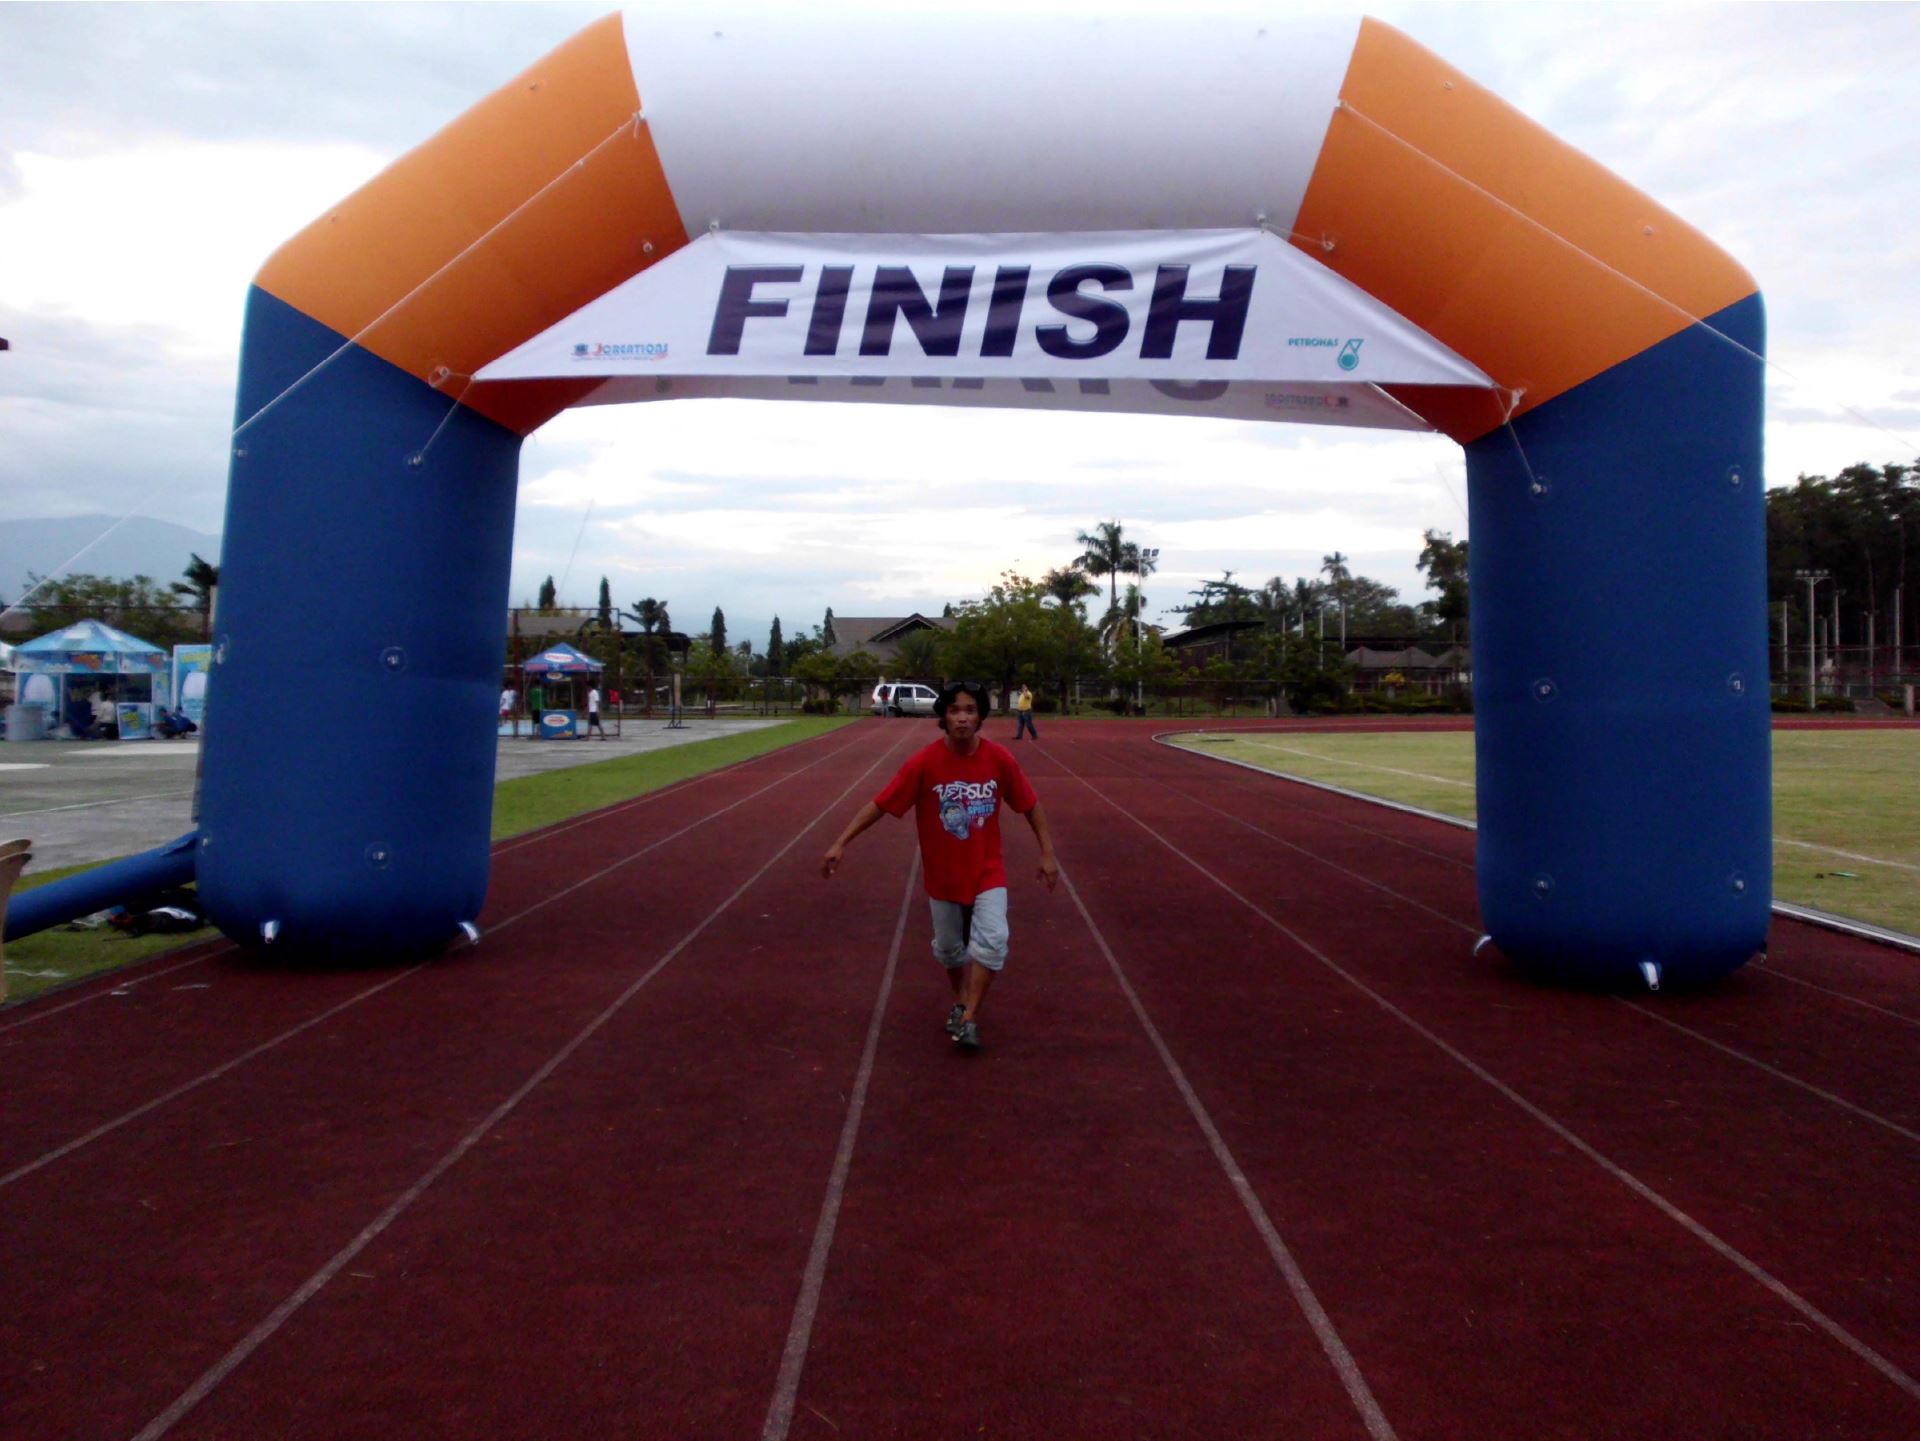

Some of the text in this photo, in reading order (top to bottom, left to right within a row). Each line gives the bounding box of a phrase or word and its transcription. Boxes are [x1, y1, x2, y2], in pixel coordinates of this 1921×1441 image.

[706, 263, 1257, 360] FINISH
[1288, 338, 1338, 347] PETRONAS
[933, 780, 997, 800] VERSUS
